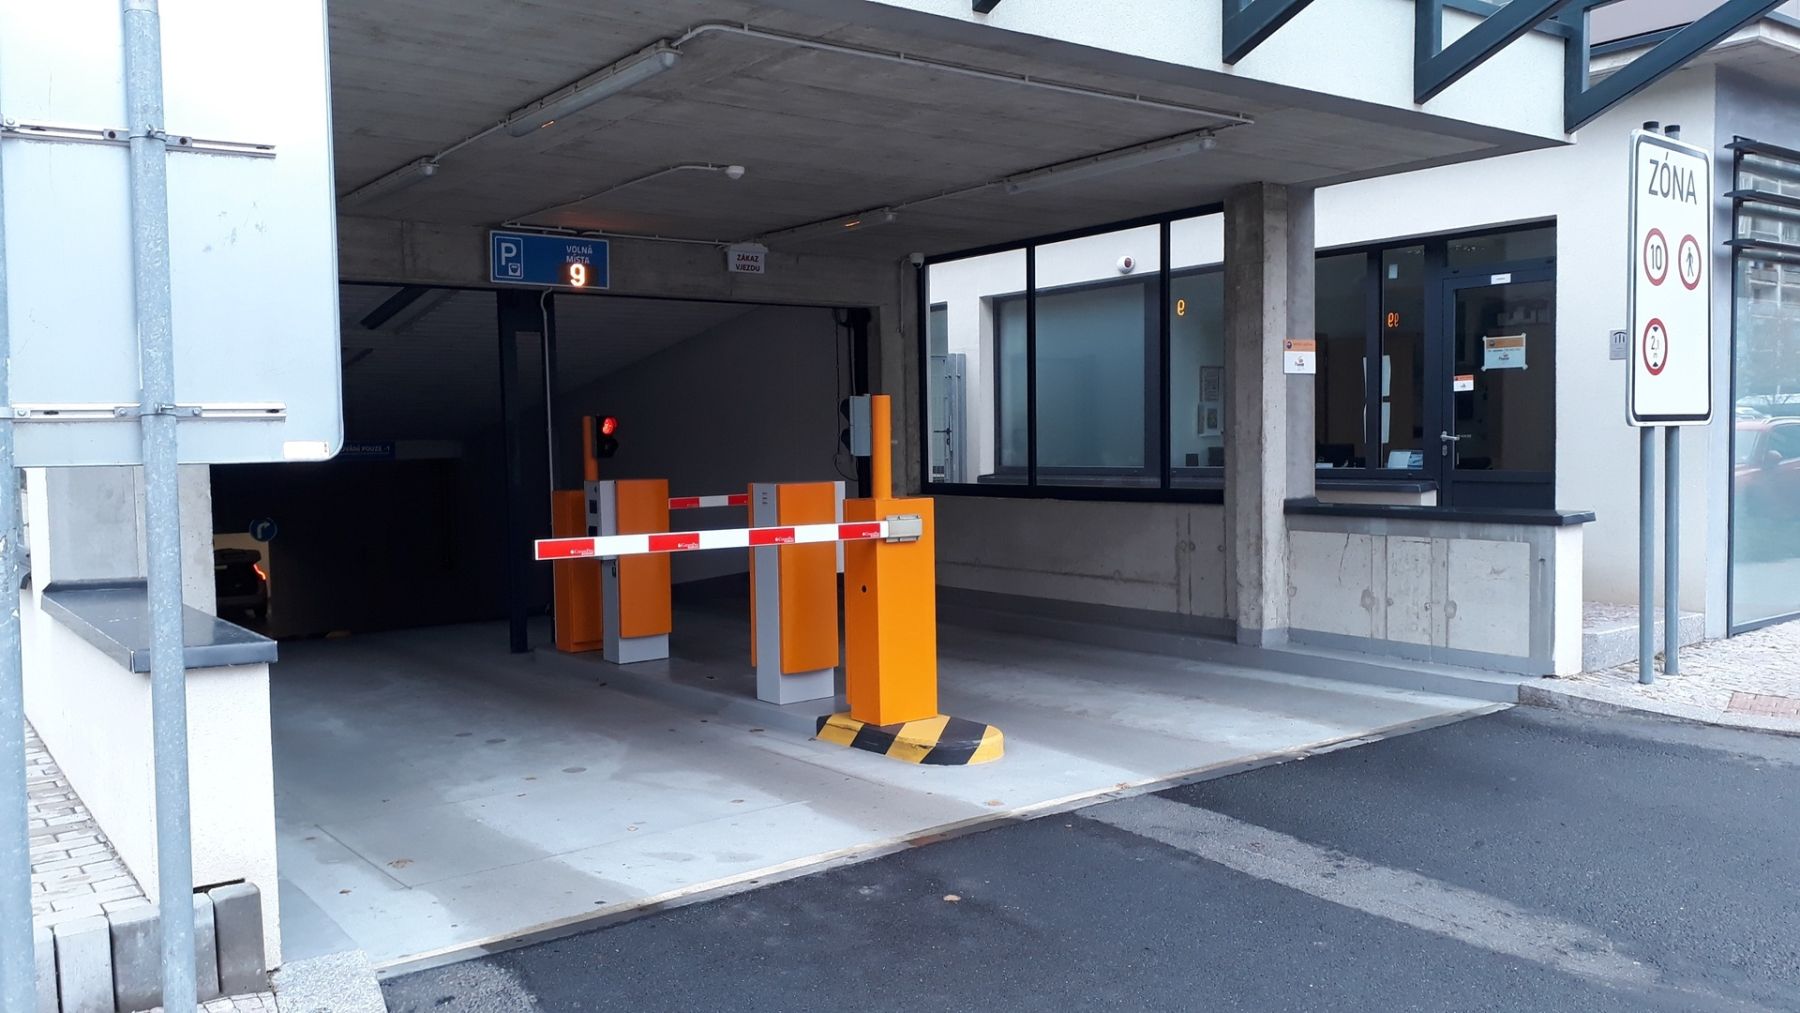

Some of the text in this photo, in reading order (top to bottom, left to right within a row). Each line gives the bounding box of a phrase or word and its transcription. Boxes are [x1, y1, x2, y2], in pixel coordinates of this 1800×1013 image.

[1648, 152, 1697, 205] ZÓNA
[566, 245, 593, 255] VOLNÁ
[566, 254, 590, 264] MÍSTA
[736, 253, 760, 263] ZÁKAZ
[1650, 244, 1663, 271] 10
[735, 263, 761, 272] VJEZDU
[570, 263, 585, 287] 9
